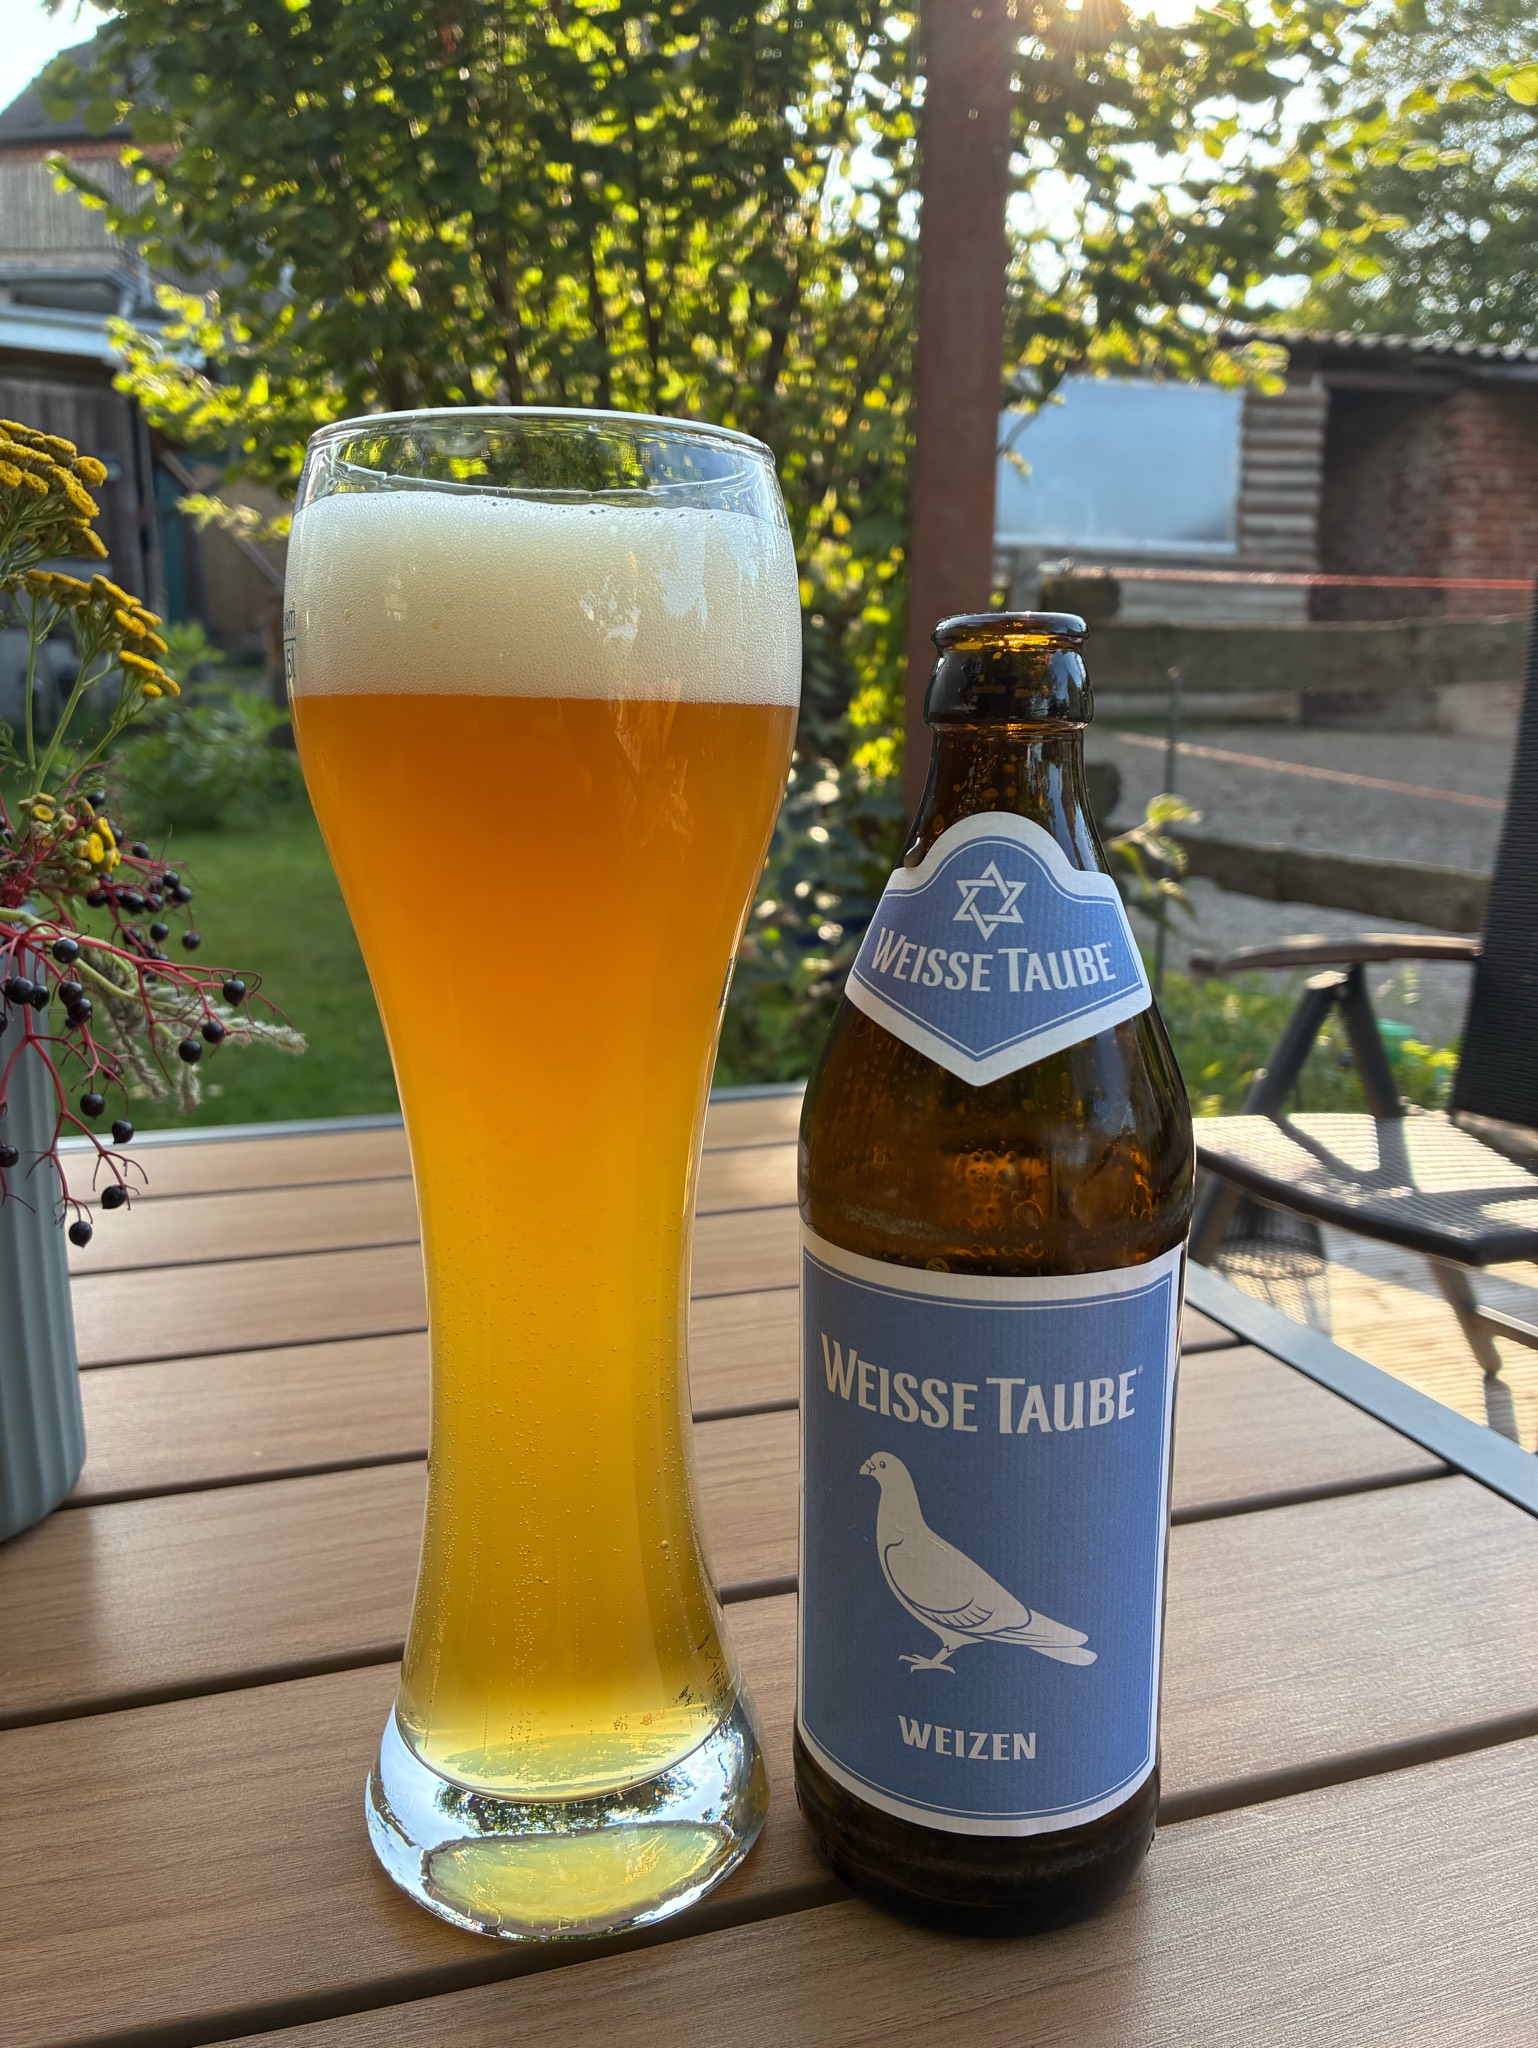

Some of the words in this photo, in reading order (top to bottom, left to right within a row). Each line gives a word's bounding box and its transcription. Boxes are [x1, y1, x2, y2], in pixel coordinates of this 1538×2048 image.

[871, 926, 993, 992] WEISSE
[821, 1332, 978, 1432] WEISSE
[898, 1715, 1036, 1761] WEIZEN
